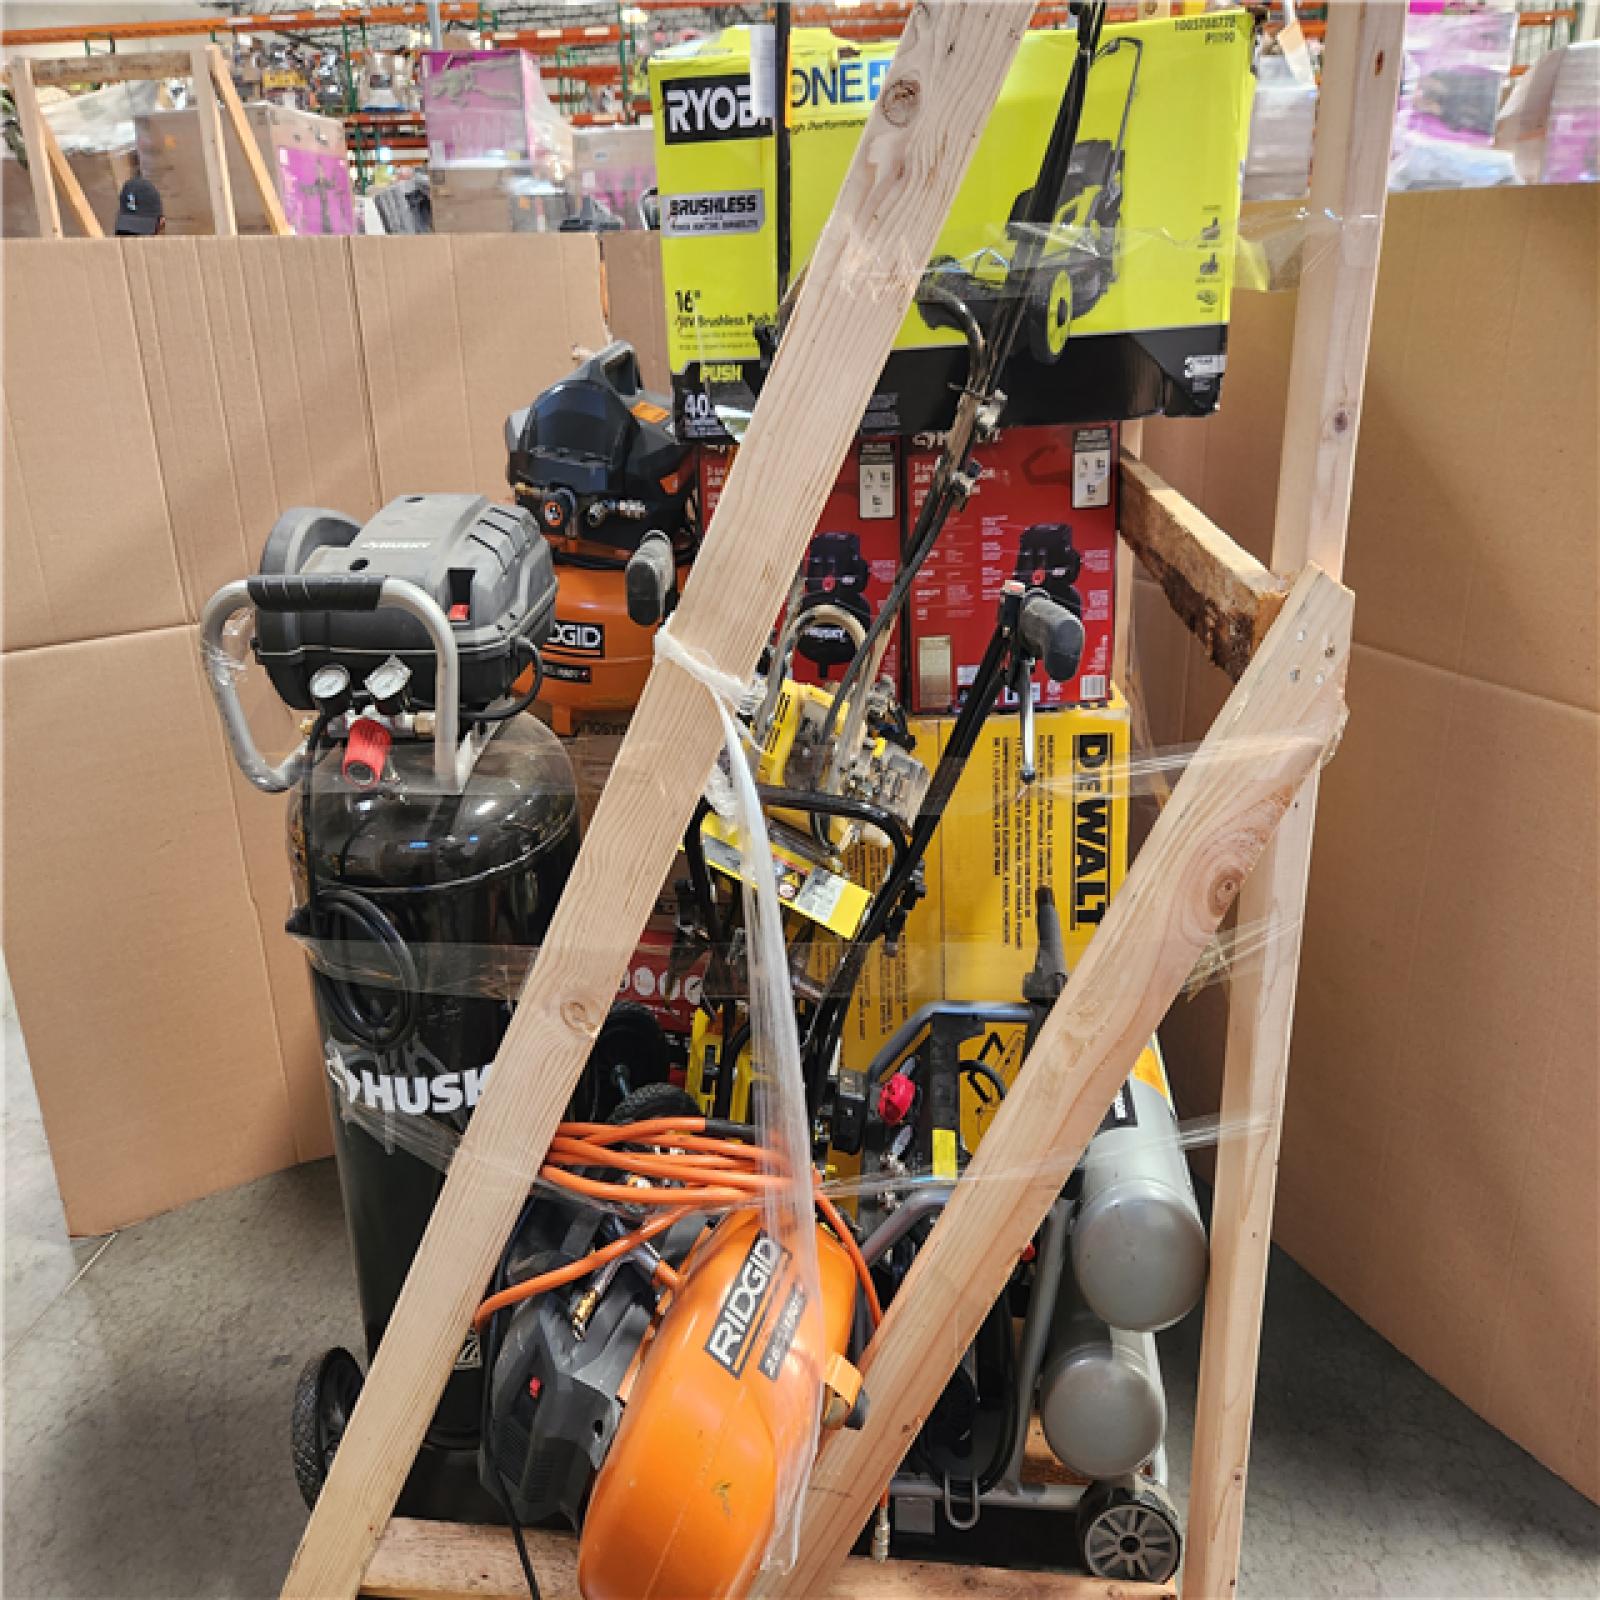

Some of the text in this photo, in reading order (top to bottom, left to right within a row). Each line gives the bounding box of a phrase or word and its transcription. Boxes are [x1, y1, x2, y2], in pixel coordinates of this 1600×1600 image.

[667, 85, 767, 133] RYOB
[670, 194, 756, 216] BRUSHLESS
[700, 364, 742, 382] PUSH
[548, 624, 601, 648] DGID
[1075, 734, 1107, 926] DEWALT
[361, 1064, 494, 1114] HUSK
[710, 1238, 781, 1366] RIDGID
